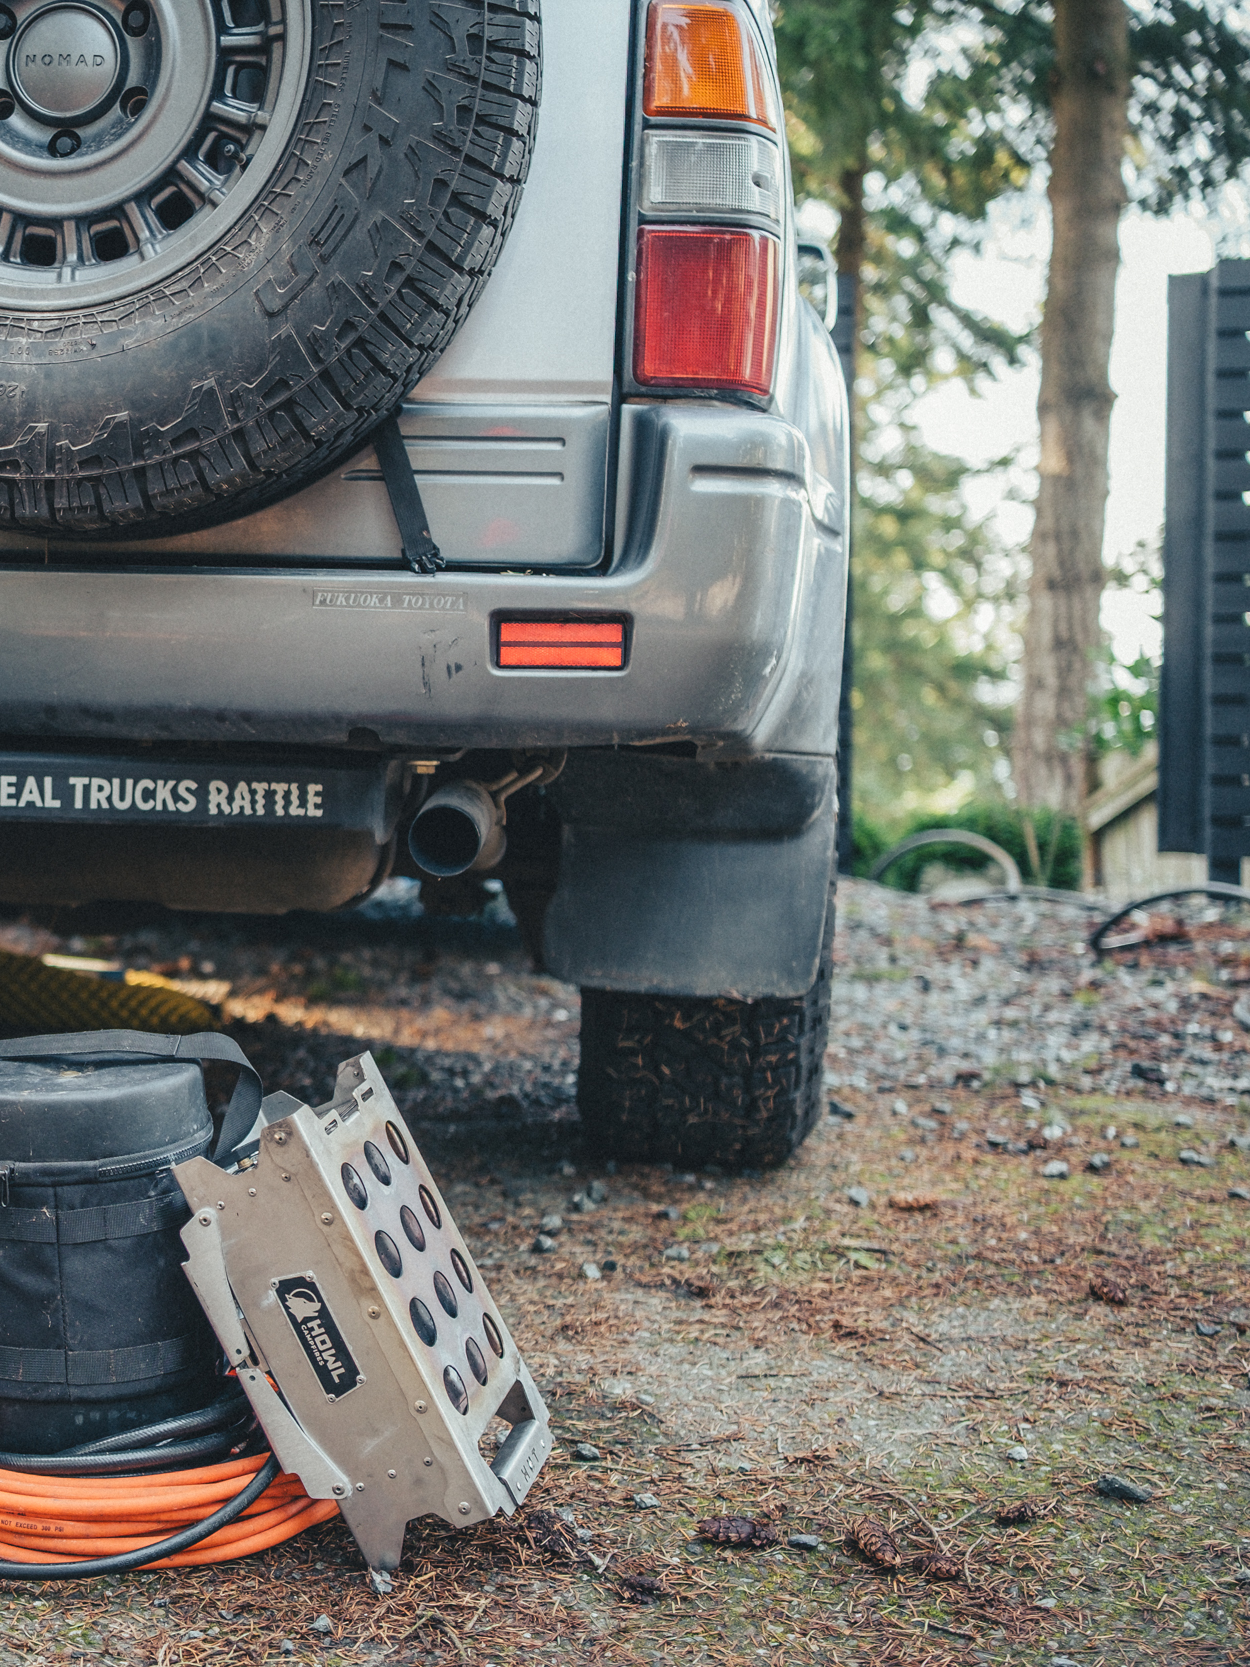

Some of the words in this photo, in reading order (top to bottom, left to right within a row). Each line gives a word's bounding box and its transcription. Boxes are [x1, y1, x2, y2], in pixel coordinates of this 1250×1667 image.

[25, 53, 105, 67] NOMAD
[314, 592, 393, 608] FUKUOKA
[402, 595, 465, 610] TOYOTA
[69, 777, 198, 812] TRUCKS
[208, 780, 324, 817] RATTLE
[301, 1324, 325, 1366] CAMPFIRES
[306, 1319, 346, 1384] HOWL
[1, 1518, 12, 1527] NOT
[15, 1520, 37, 1530] EXCEED
